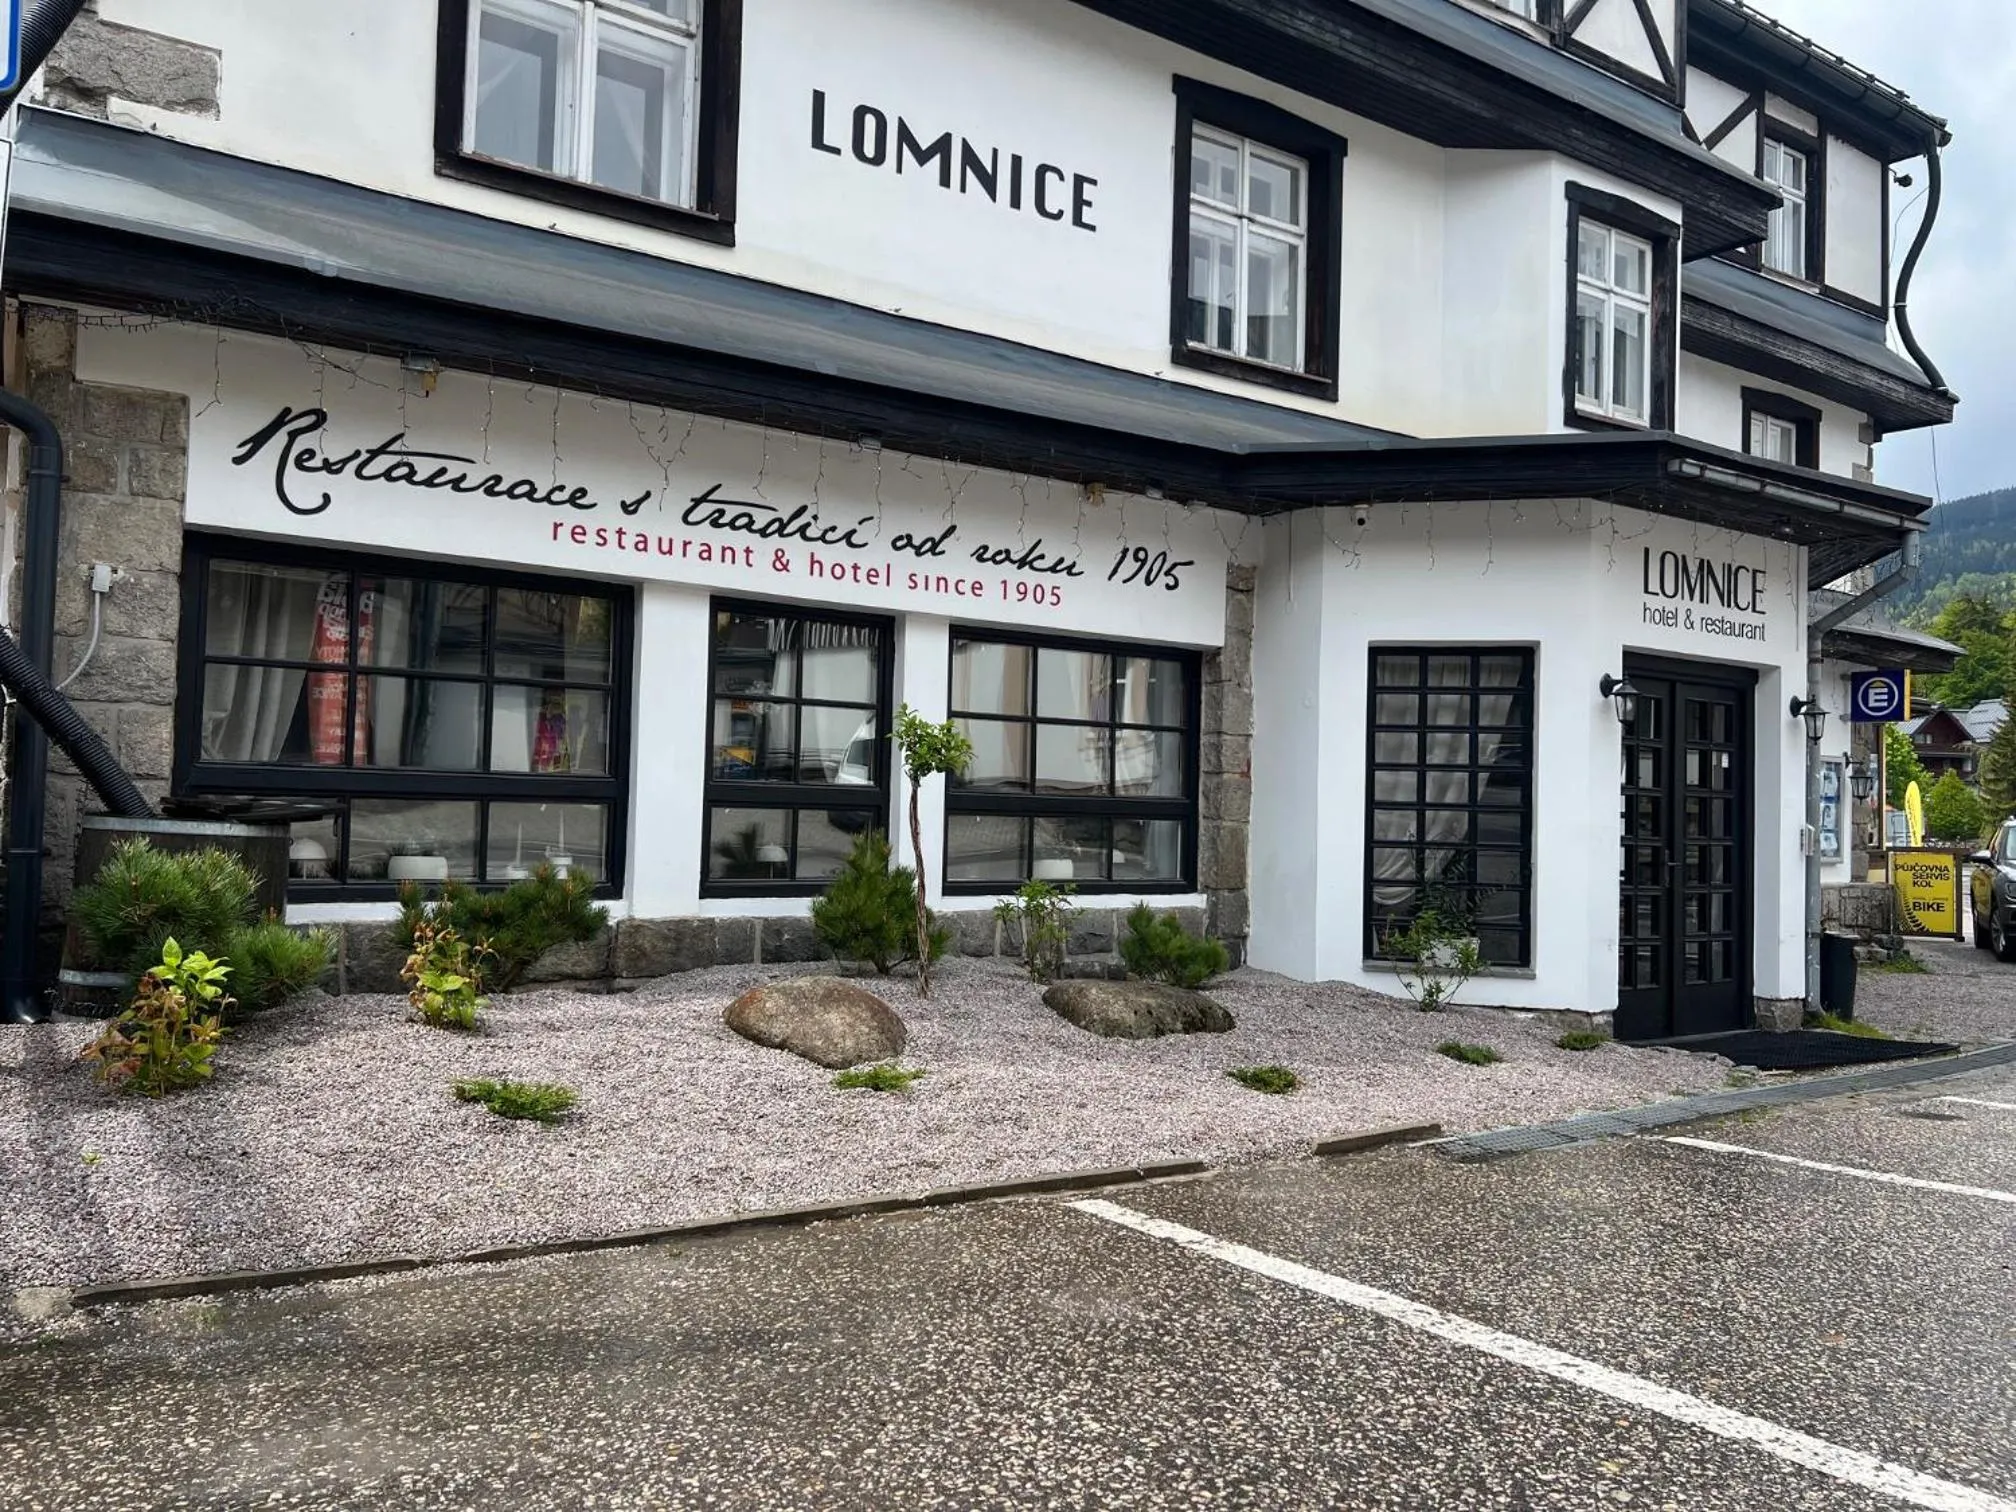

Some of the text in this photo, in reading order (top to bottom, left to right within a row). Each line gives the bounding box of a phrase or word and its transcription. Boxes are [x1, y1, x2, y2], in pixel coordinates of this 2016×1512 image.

[810, 87, 1099, 233] LOMNICE
[231, 406, 1196, 591] Restaurace s tradicí od roku 1905
[551, 521, 1062, 606] restaurant & hotel since 1905
[1643, 546, 1767, 616] LOMNICE
[1642, 601, 1767, 642] hotel & restaurant
[1911, 872, 1951, 881] SERVIS
[1912, 880, 1935, 888] KOL
[1912, 901, 1946, 913] BIKE
